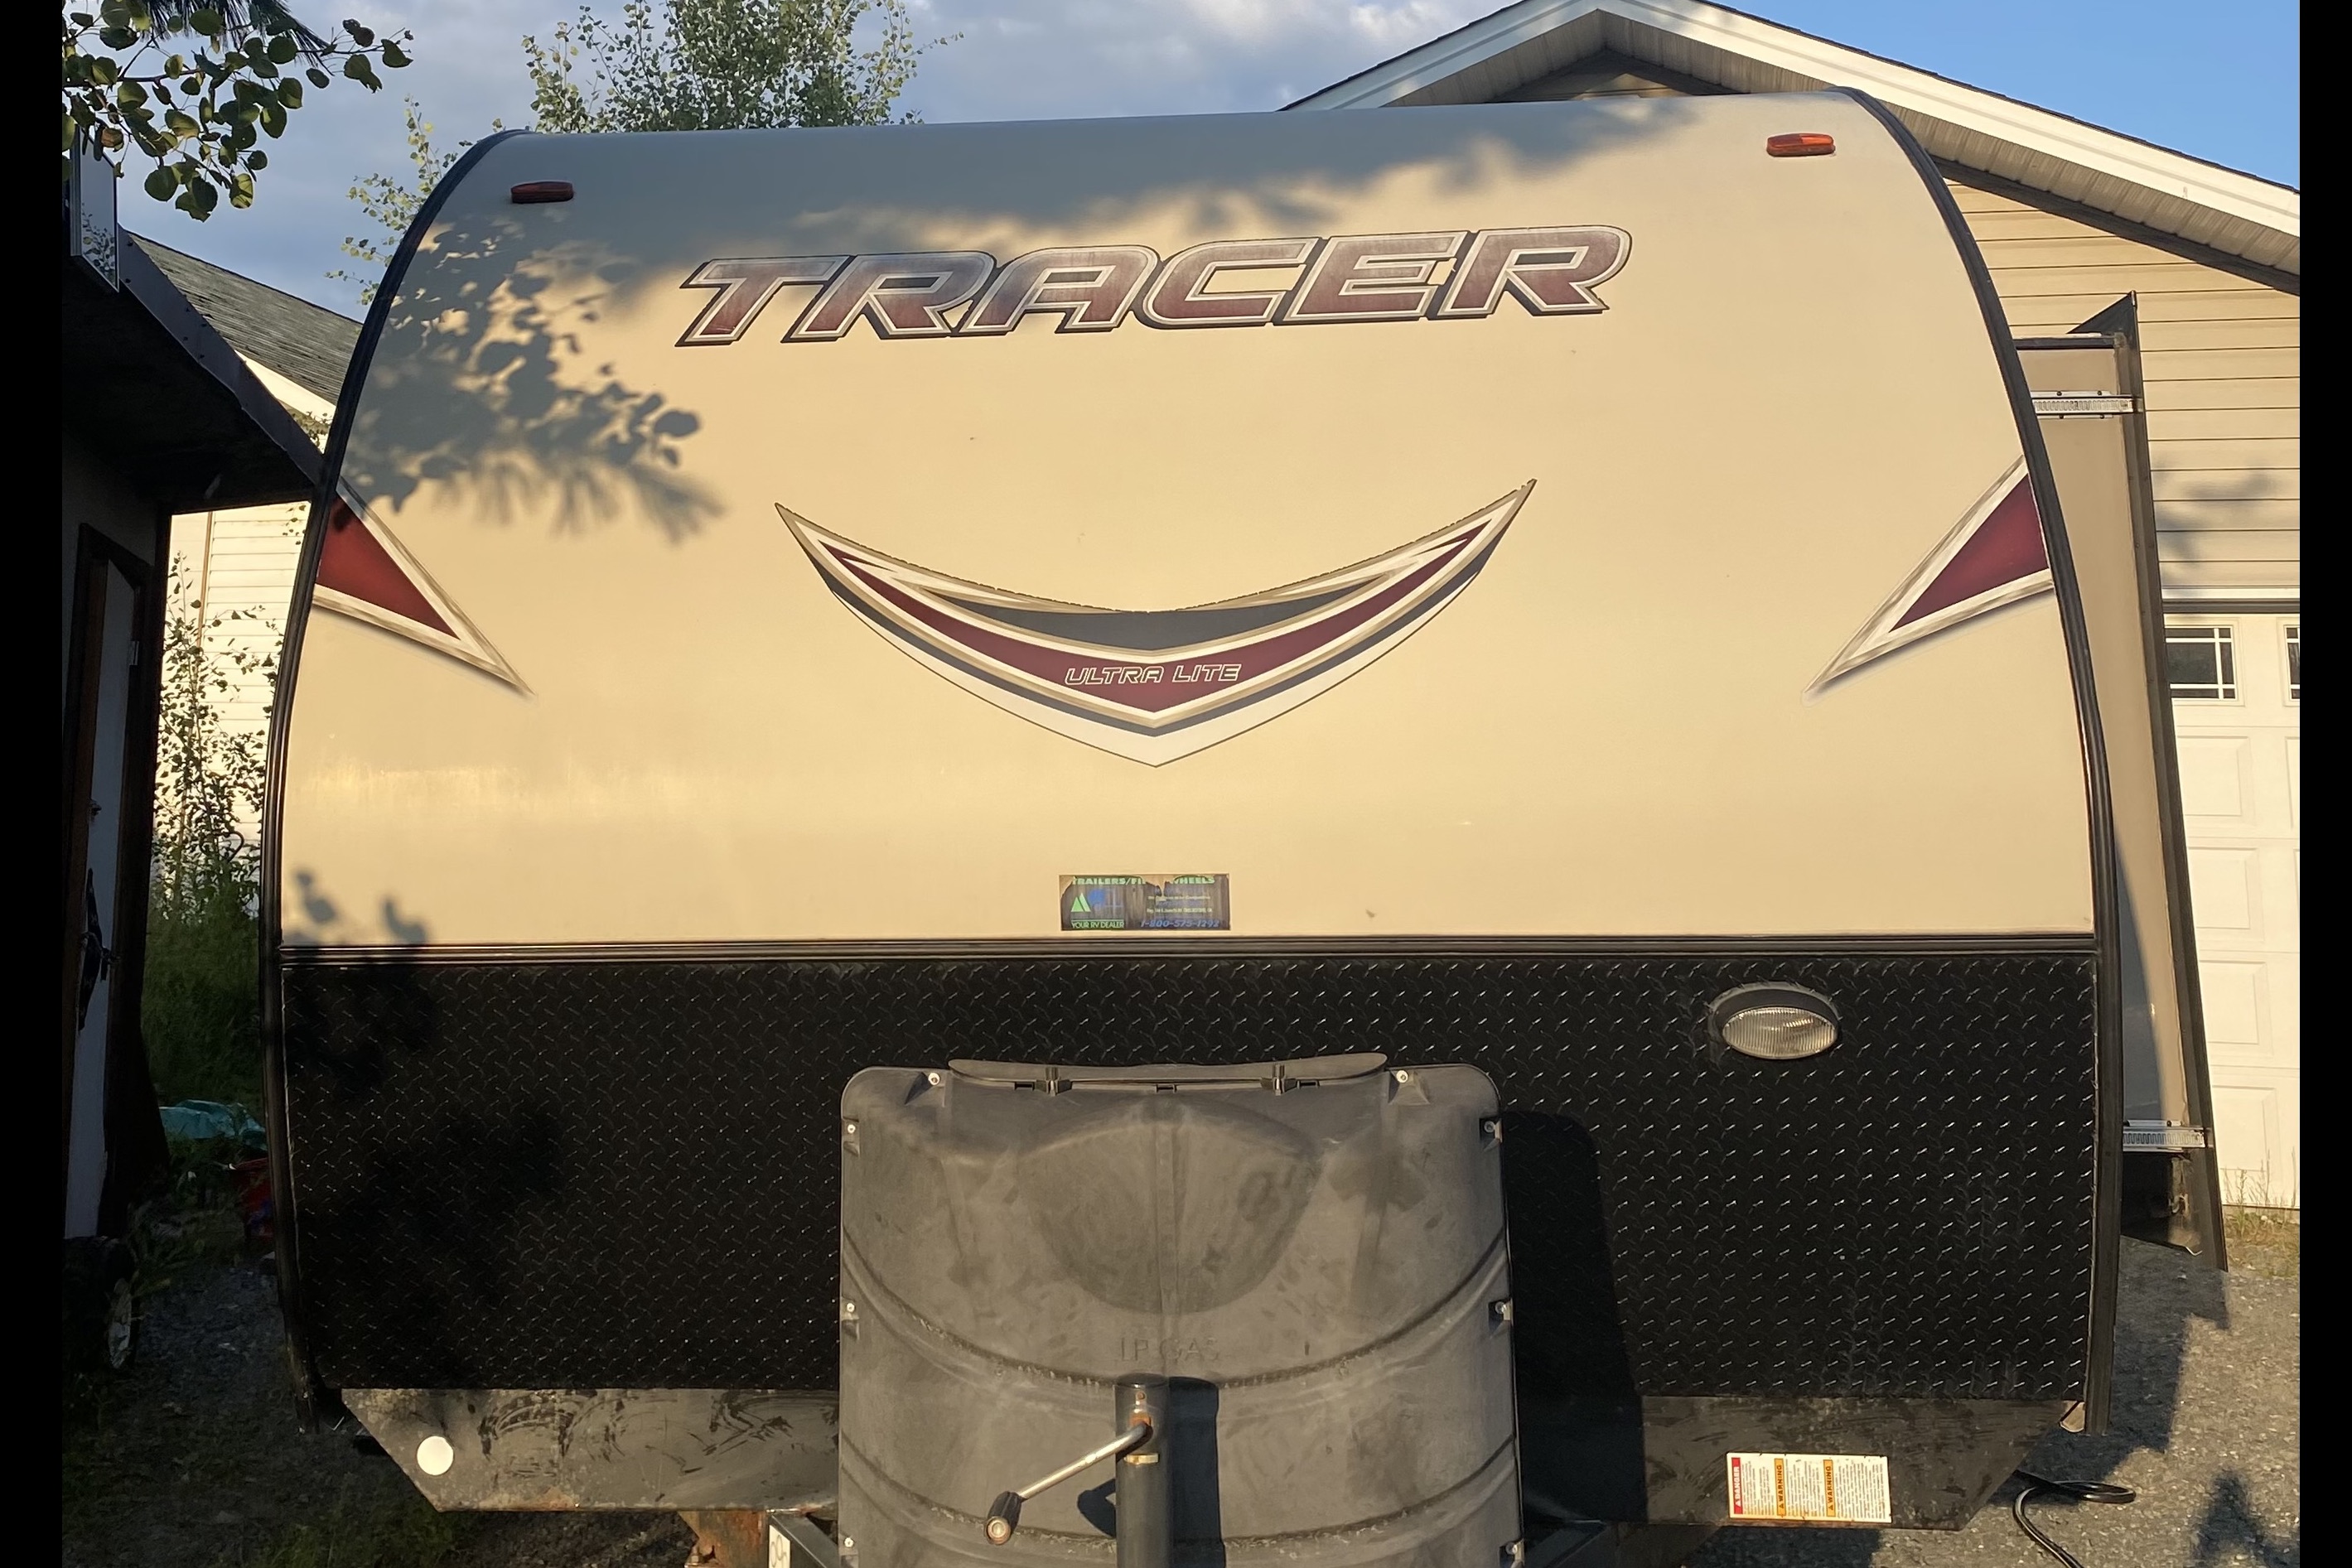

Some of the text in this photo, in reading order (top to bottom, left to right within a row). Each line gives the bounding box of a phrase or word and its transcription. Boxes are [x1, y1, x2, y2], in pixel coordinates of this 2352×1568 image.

[674, 224, 1632, 347] TRACER
[1065, 663, 1242, 685] ULTRA LITE
[1071, 920, 1089, 929] YOUR
[1100, 920, 1125, 929] DEALER
[1160, 1337, 1220, 1361] GAS
[1733, 1465, 1741, 1500] DANGER
[1825, 1465, 1834, 1504] WARNING
